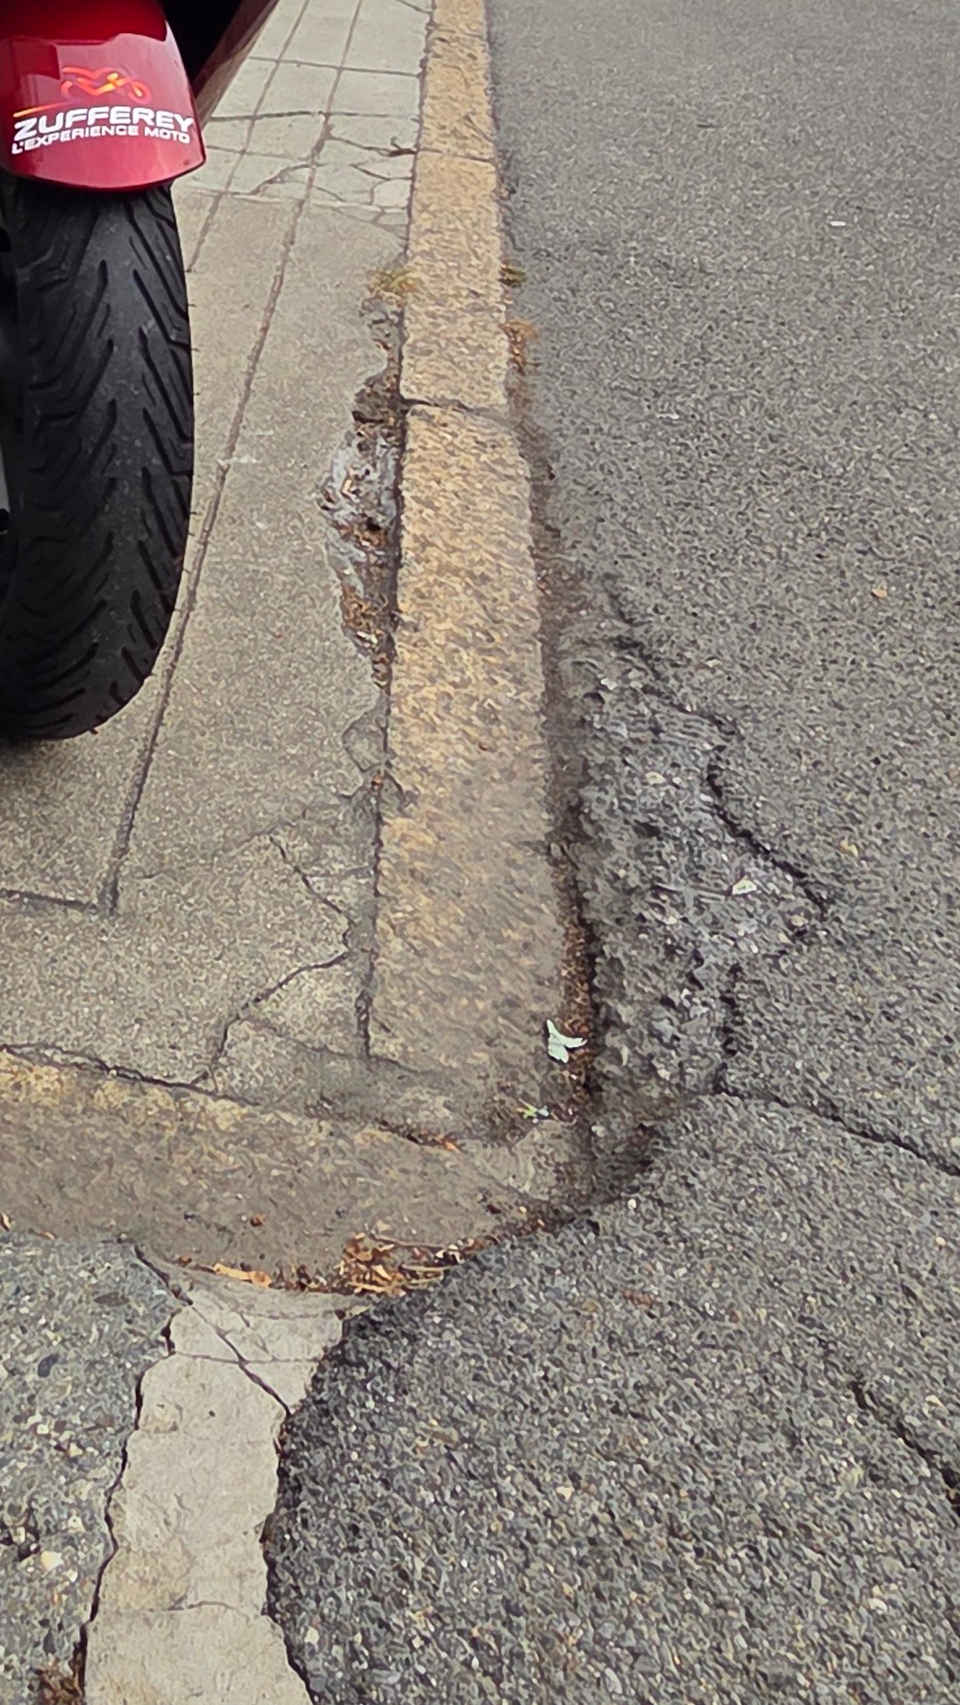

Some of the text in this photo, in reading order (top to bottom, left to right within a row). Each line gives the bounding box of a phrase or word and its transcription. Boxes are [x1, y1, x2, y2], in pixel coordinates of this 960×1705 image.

[11, 125, 191, 155] L'EXPERIENCE MOTO
[13, 106, 195, 142] ZUFFEREY
